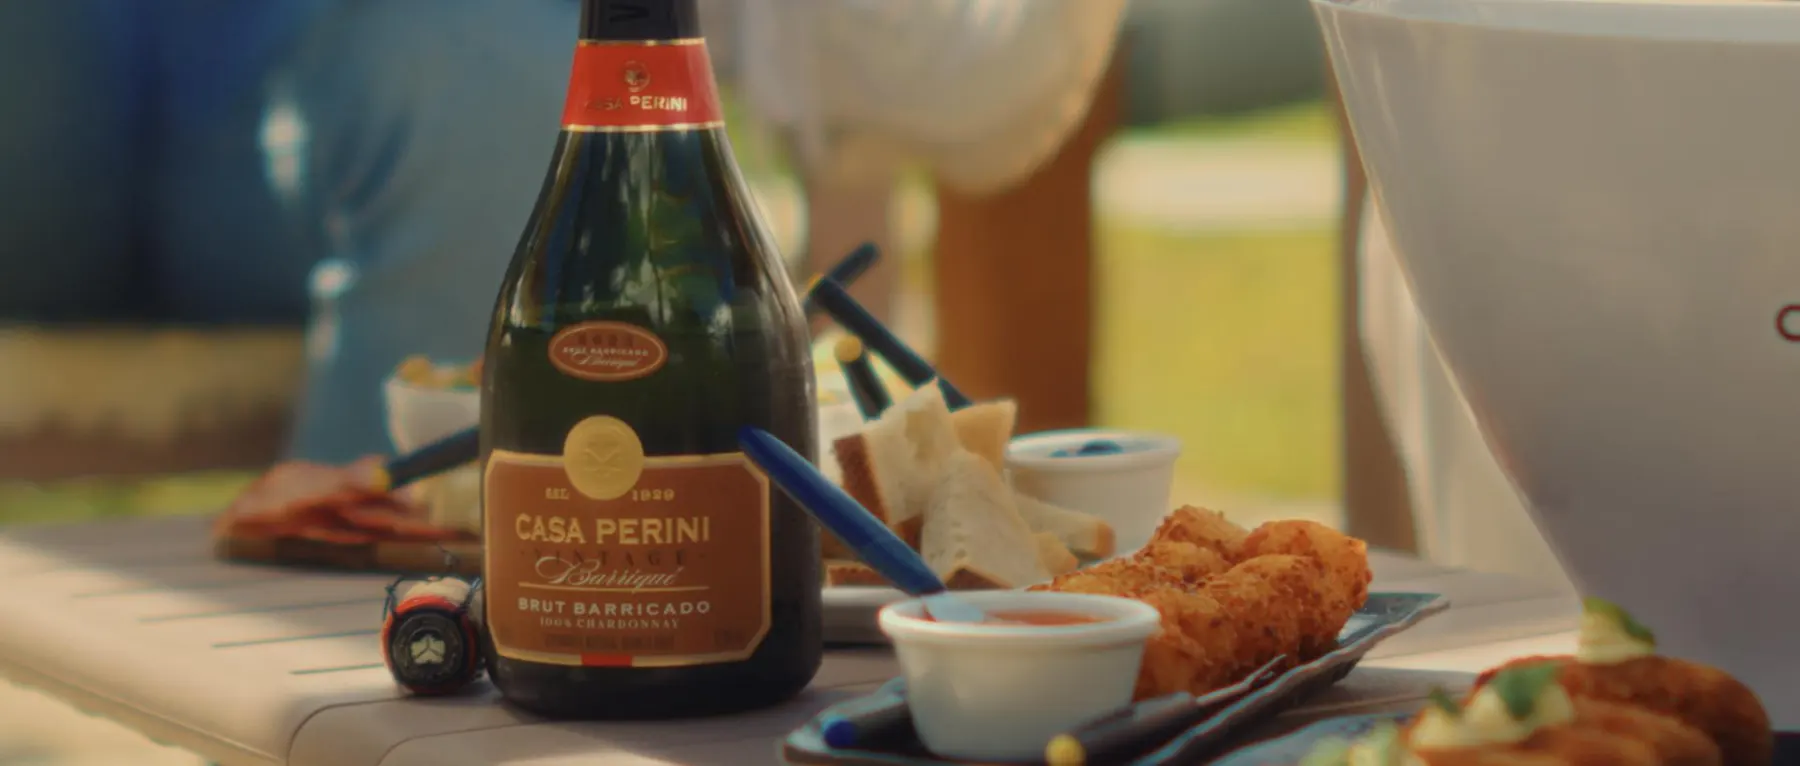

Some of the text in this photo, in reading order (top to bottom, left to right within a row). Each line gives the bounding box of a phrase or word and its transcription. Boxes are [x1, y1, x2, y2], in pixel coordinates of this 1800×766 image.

[629, 95, 688, 112] PERINI
[515, 513, 710, 545] CASA PERINI
[517, 597, 711, 616] BRUT BARRICADO
[540, 616, 681, 629] 100% CHARDONNAY
